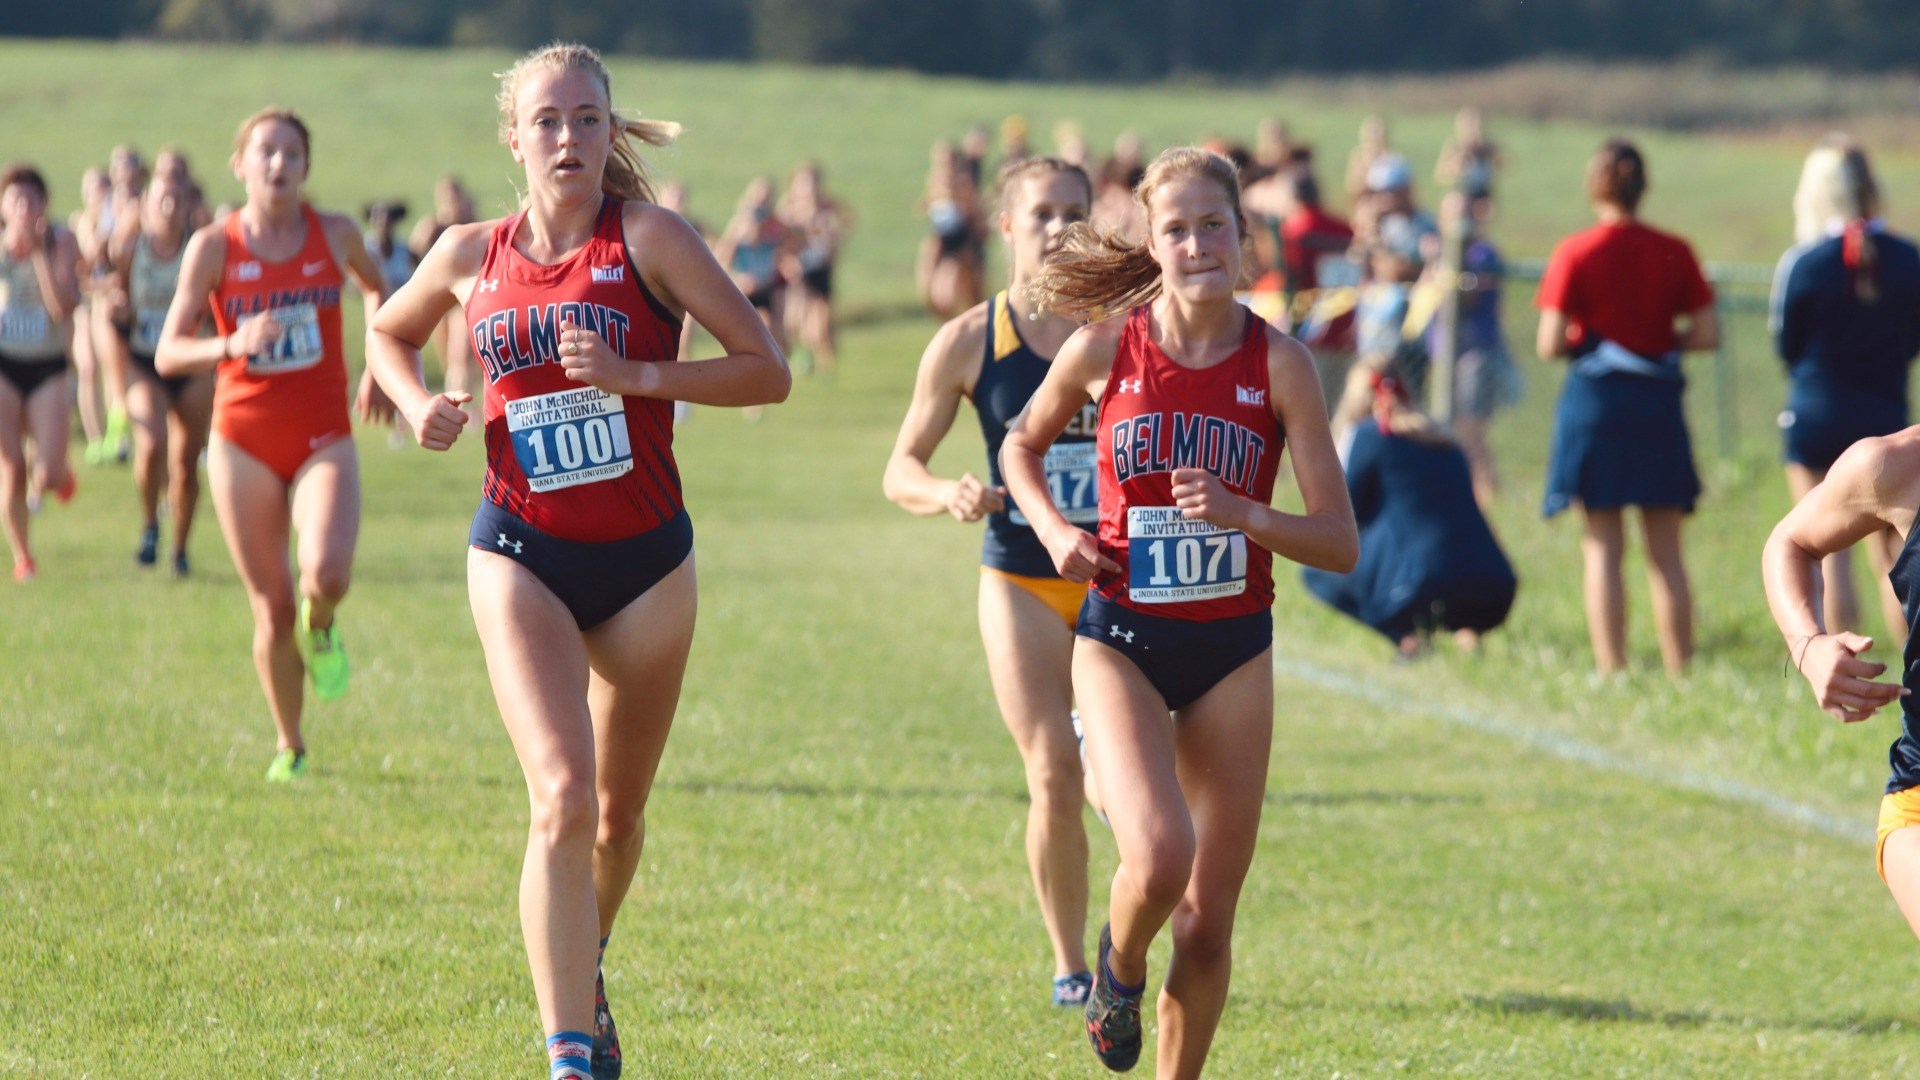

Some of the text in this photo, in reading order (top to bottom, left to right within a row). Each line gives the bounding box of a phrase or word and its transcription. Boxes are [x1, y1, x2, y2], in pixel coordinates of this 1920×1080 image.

[591, 264, 624, 283] VALLEY
[513, 398, 542, 415] JOHN
[521, 401, 606, 427] INVITATIONAL
[527, 417, 613, 476] 100
[1112, 412, 1265, 495] BELMONT
[556, 472, 580, 483] STATE
[582, 463, 625, 478] UNIVERSITY
[1136, 510, 1167, 522] JOHN
[1143, 521, 1229, 535] INVITATION
[1148, 535, 1228, 586] 107
[1138, 583, 1237, 598] INDIANA STATE UNIVERSITY
